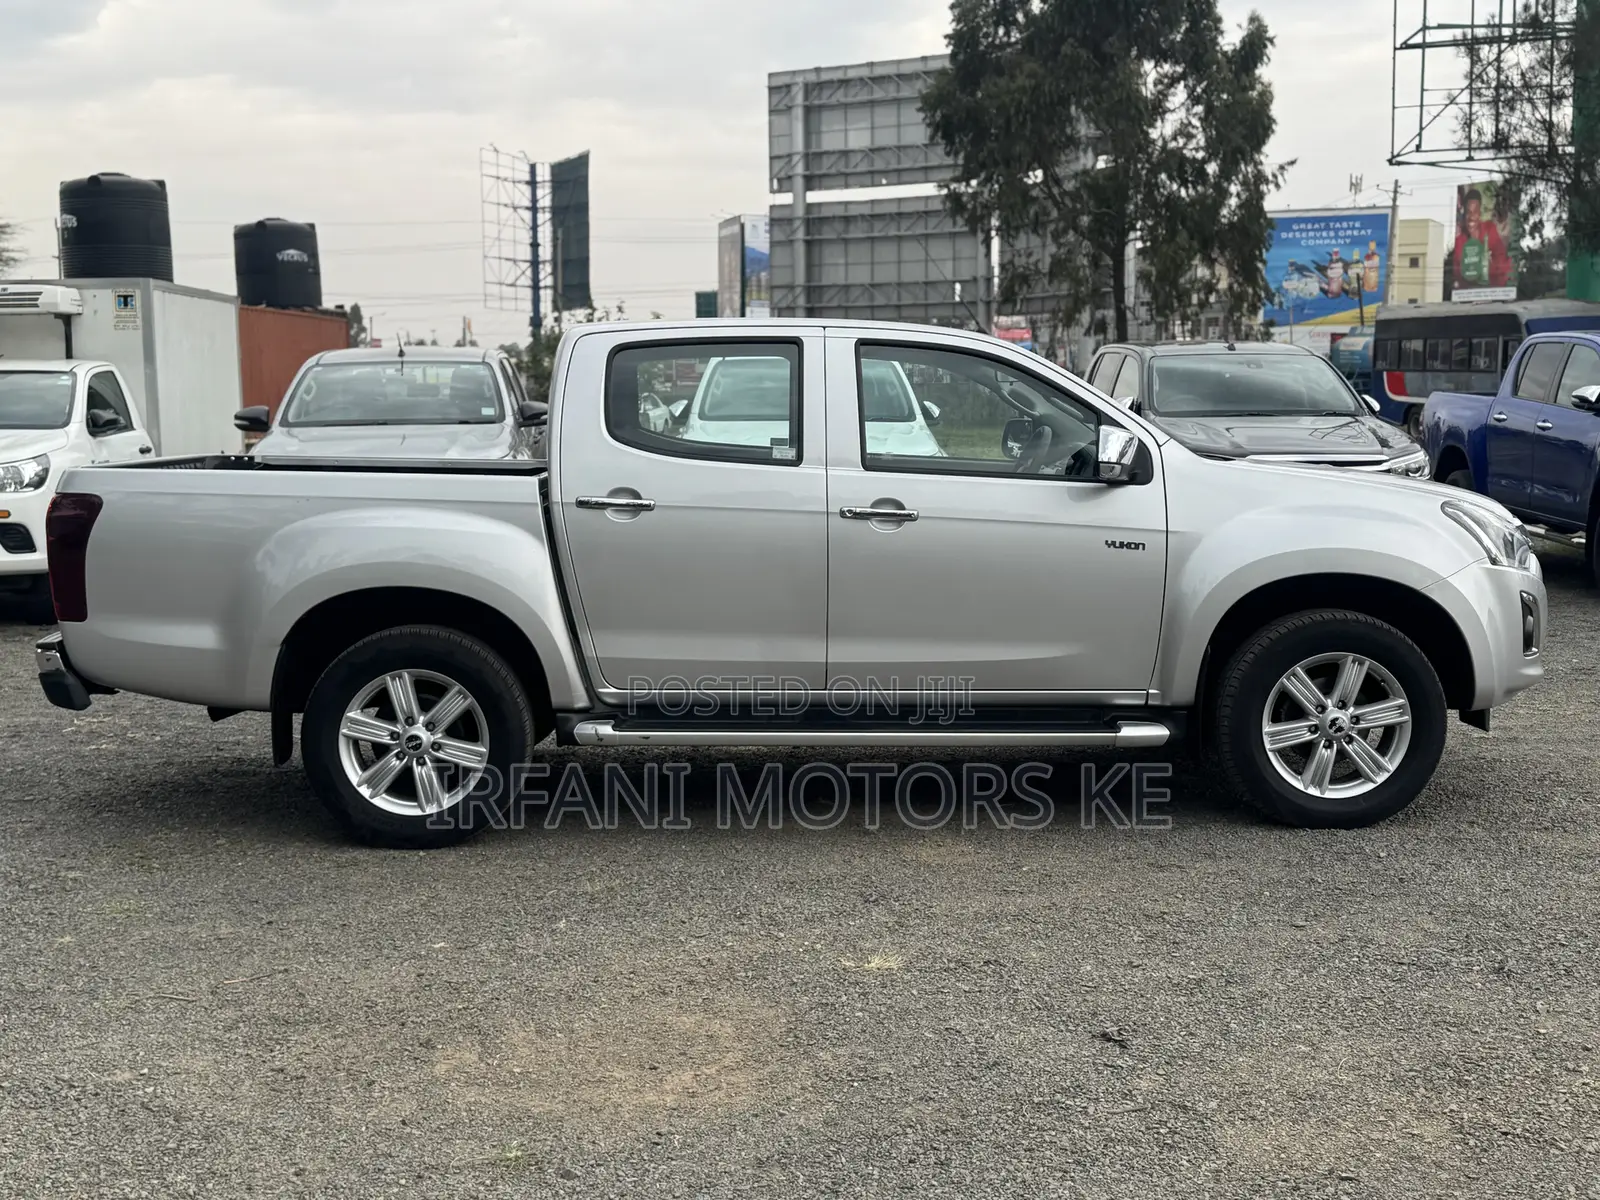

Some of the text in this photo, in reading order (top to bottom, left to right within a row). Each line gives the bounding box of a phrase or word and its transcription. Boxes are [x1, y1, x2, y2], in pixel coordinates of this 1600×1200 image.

[1292, 221, 1361, 230] GREAT TASTE
[1280, 229, 1373, 239] DESERVES GREAT
[1301, 238, 1351, 246] COMPANY
[1104, 539, 1146, 551] YUKON
